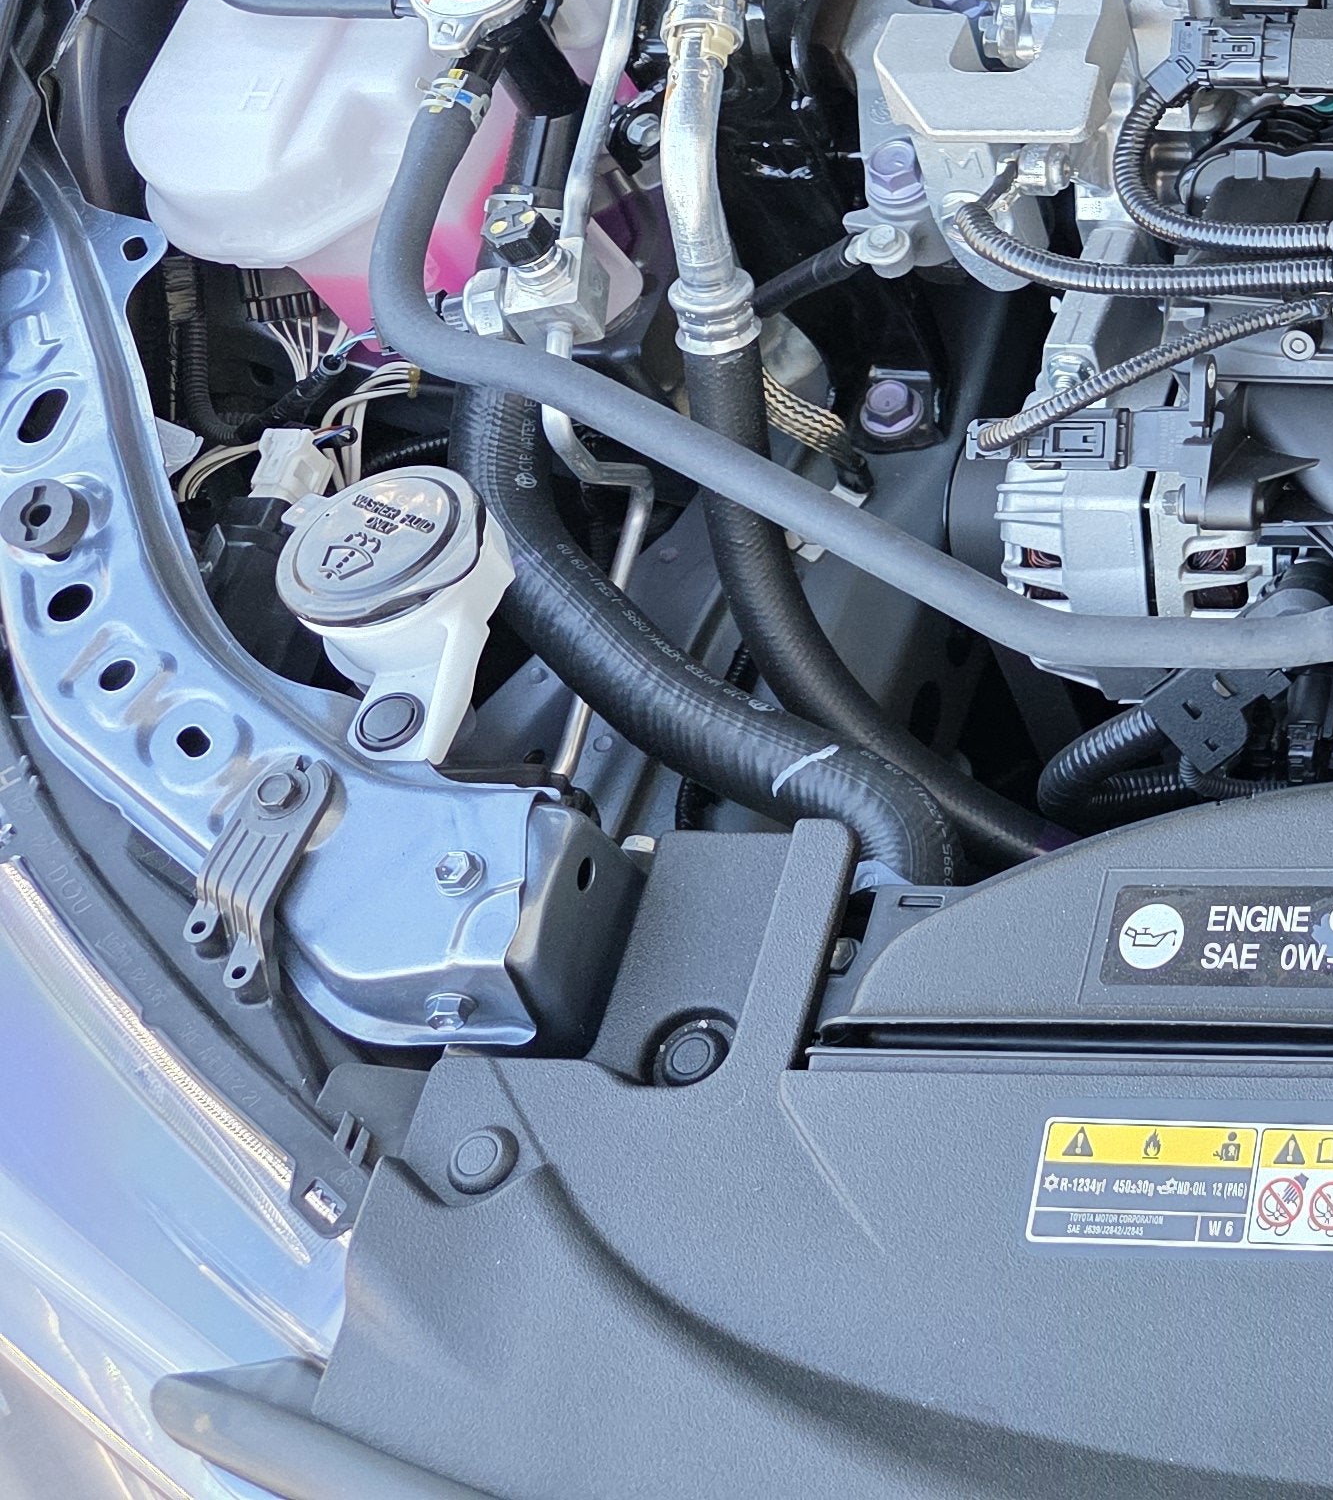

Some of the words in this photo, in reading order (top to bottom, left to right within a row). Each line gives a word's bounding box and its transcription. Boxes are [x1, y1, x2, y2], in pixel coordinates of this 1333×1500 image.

[938, 148, 985, 179] M
[365, 516, 399, 535] ONLY
[1206, 905, 1312, 933] ENGINE
[1200, 942, 1260, 970] SAE
[1059, 1177, 1107, 1195] R-1234yf
[1112, 1179, 1155, 1197] 450±30g
[1212, 1183, 1222, 1196] 12
[1223, 1182, 1248, 1199] (PAG)
[1069, 1212, 1095, 1222] TOYOTA
[1095, 1213, 1118, 1223] MOTOR
[1119, 1214, 1164, 1225] CORPORATION
[1208, 1220, 1223, 1236] W
[1225, 1221, 1234, 1236] 6
[1066, 1224, 1080, 1234] SAE
